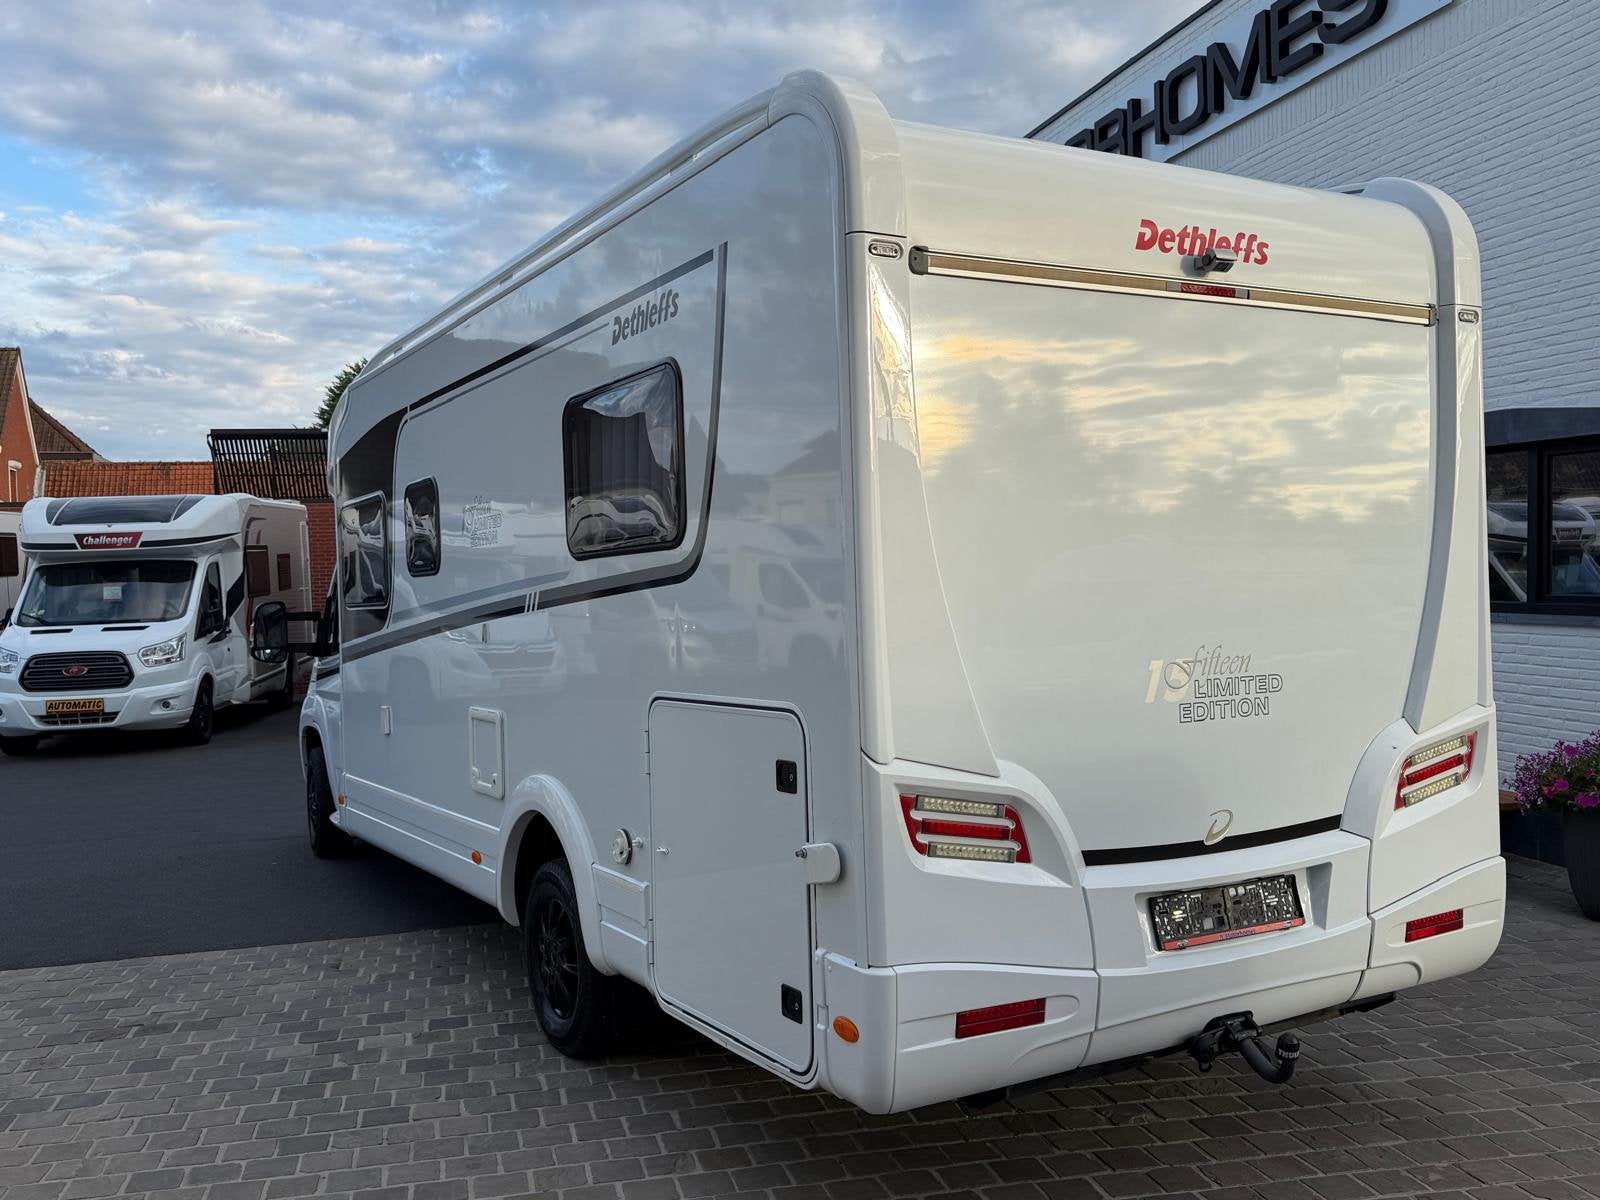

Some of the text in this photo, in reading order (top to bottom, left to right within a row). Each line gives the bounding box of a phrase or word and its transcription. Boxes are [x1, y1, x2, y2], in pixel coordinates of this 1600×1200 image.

[1135, 218, 1269, 266] Dethleffs
[611, 288, 680, 346] Dethleffs
[83, 535, 134, 547] Challenger
[1194, 673, 1283, 699] LIMITED
[47, 700, 103, 711] AUTOMATIC
[1178, 696, 1270, 724] EDITION
